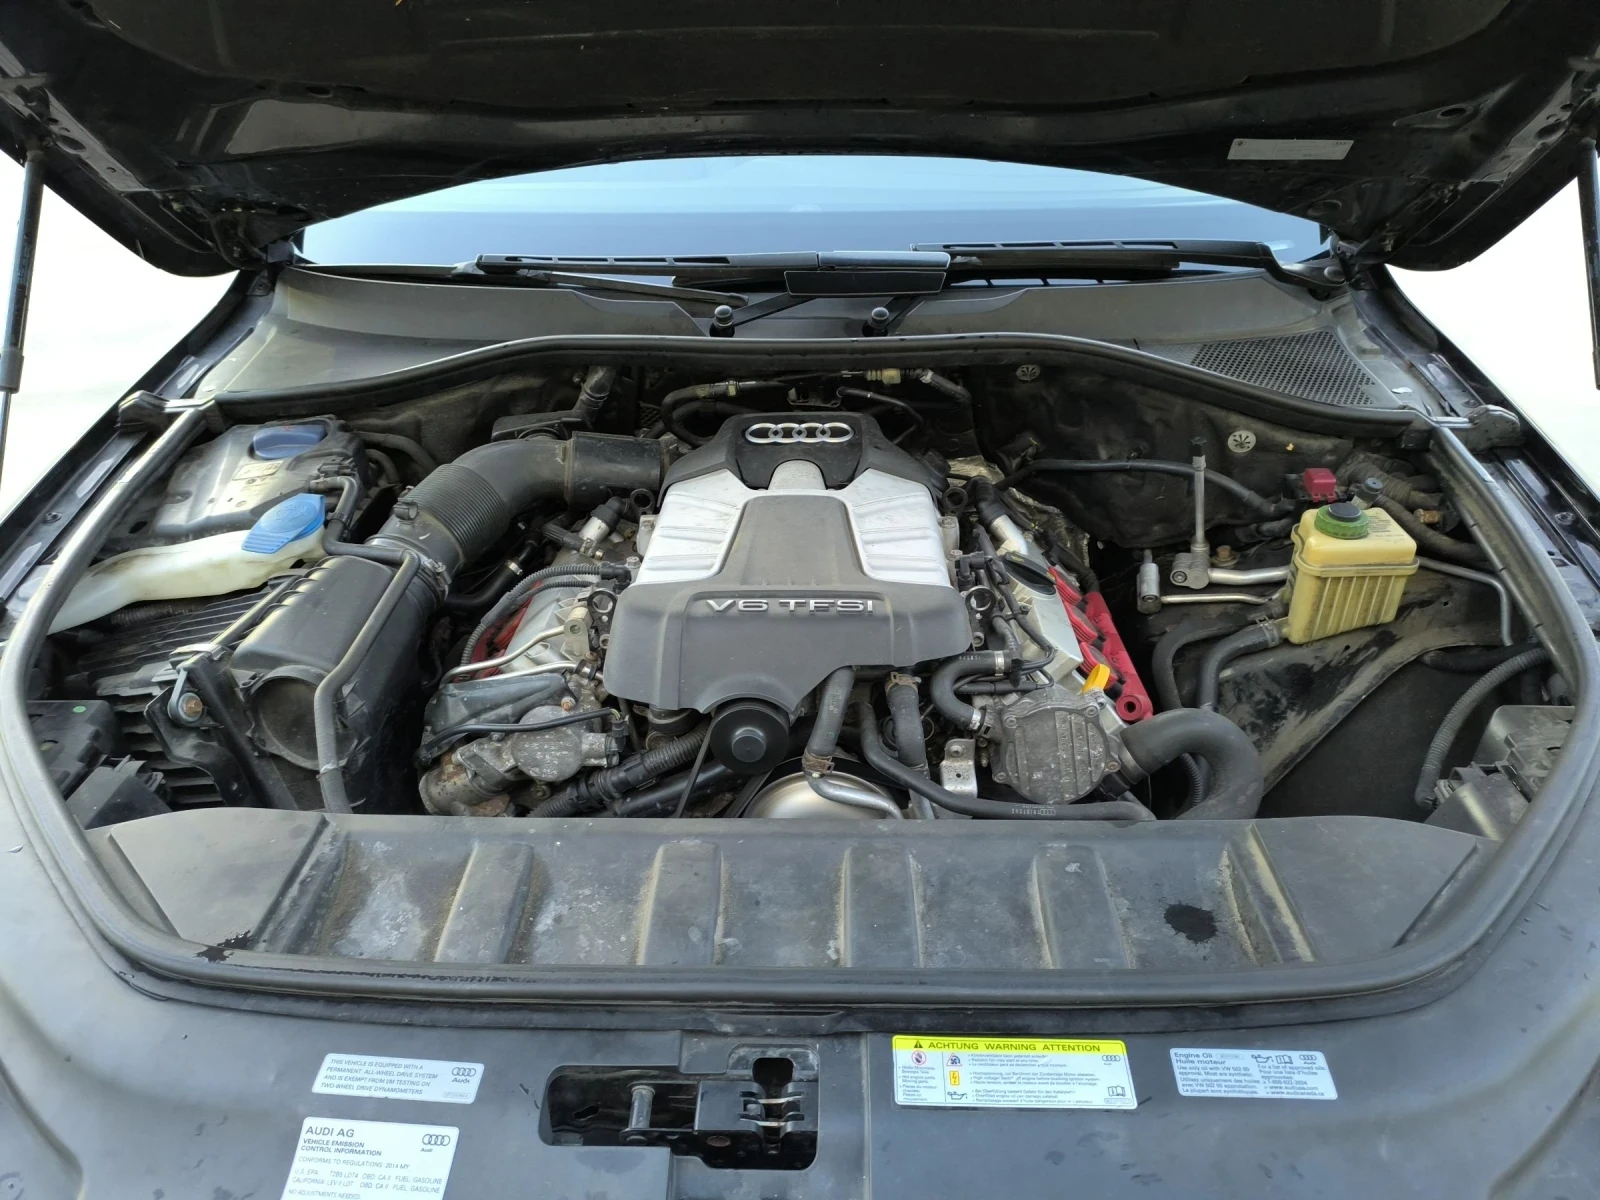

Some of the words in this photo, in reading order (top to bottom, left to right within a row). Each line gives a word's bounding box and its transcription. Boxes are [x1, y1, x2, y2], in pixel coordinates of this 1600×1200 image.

[706, 599, 769, 613] V6
[779, 599, 875, 615] TFSI
[928, 1042, 979, 1050] ACHTUNG
[984, 1043, 1036, 1051] WARNING
[1042, 1044, 1101, 1052] ATTENTION
[326, 1066, 362, 1074] PERMANENT
[364, 1069, 395, 1077] ALL-WHEEL
[321, 1082, 355, 1090] TWO-WHEEL
[374, 1086, 424, 1095] DYNAMOMETERS
[396, 1079, 421, 1087] TESTING
[304, 1126, 335, 1137] AUDI
[336, 1128, 355, 1138] AG
[303, 1138, 331, 1146] VEHICLE
[331, 1140, 365, 1149] EMISSION
[300, 1145, 332, 1153] CONTROL
[333, 1147, 383, 1157] INFORMATION
[298, 1156, 332, 1164] CONFORMS
[412, 1176, 443, 1185] GASOLINE
[410, 1185, 441, 1194] GASOLINE
